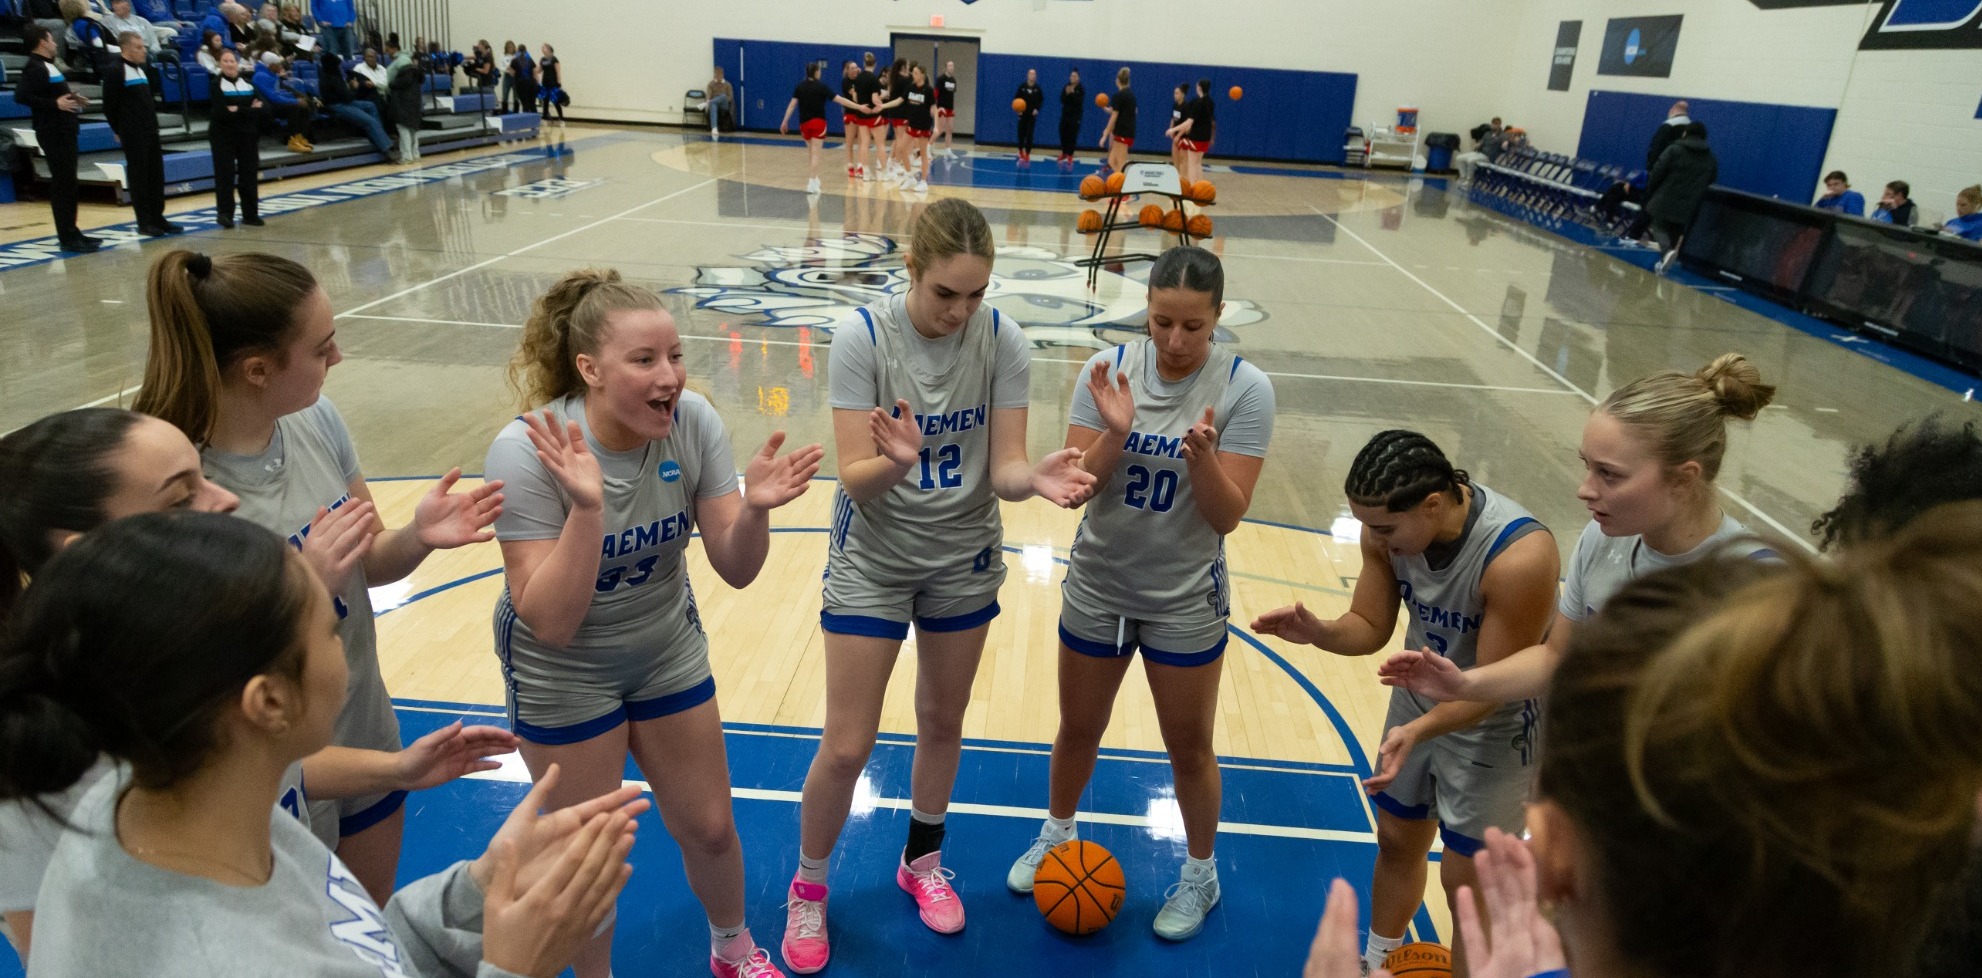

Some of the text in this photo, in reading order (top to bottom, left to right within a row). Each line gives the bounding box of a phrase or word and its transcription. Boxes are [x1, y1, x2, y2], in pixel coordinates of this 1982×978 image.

[662, 468, 680, 478] NCAA
[918, 443, 963, 490] 12
[1124, 464, 1179, 513] 20
[602, 505, 690, 559] AEMEN
